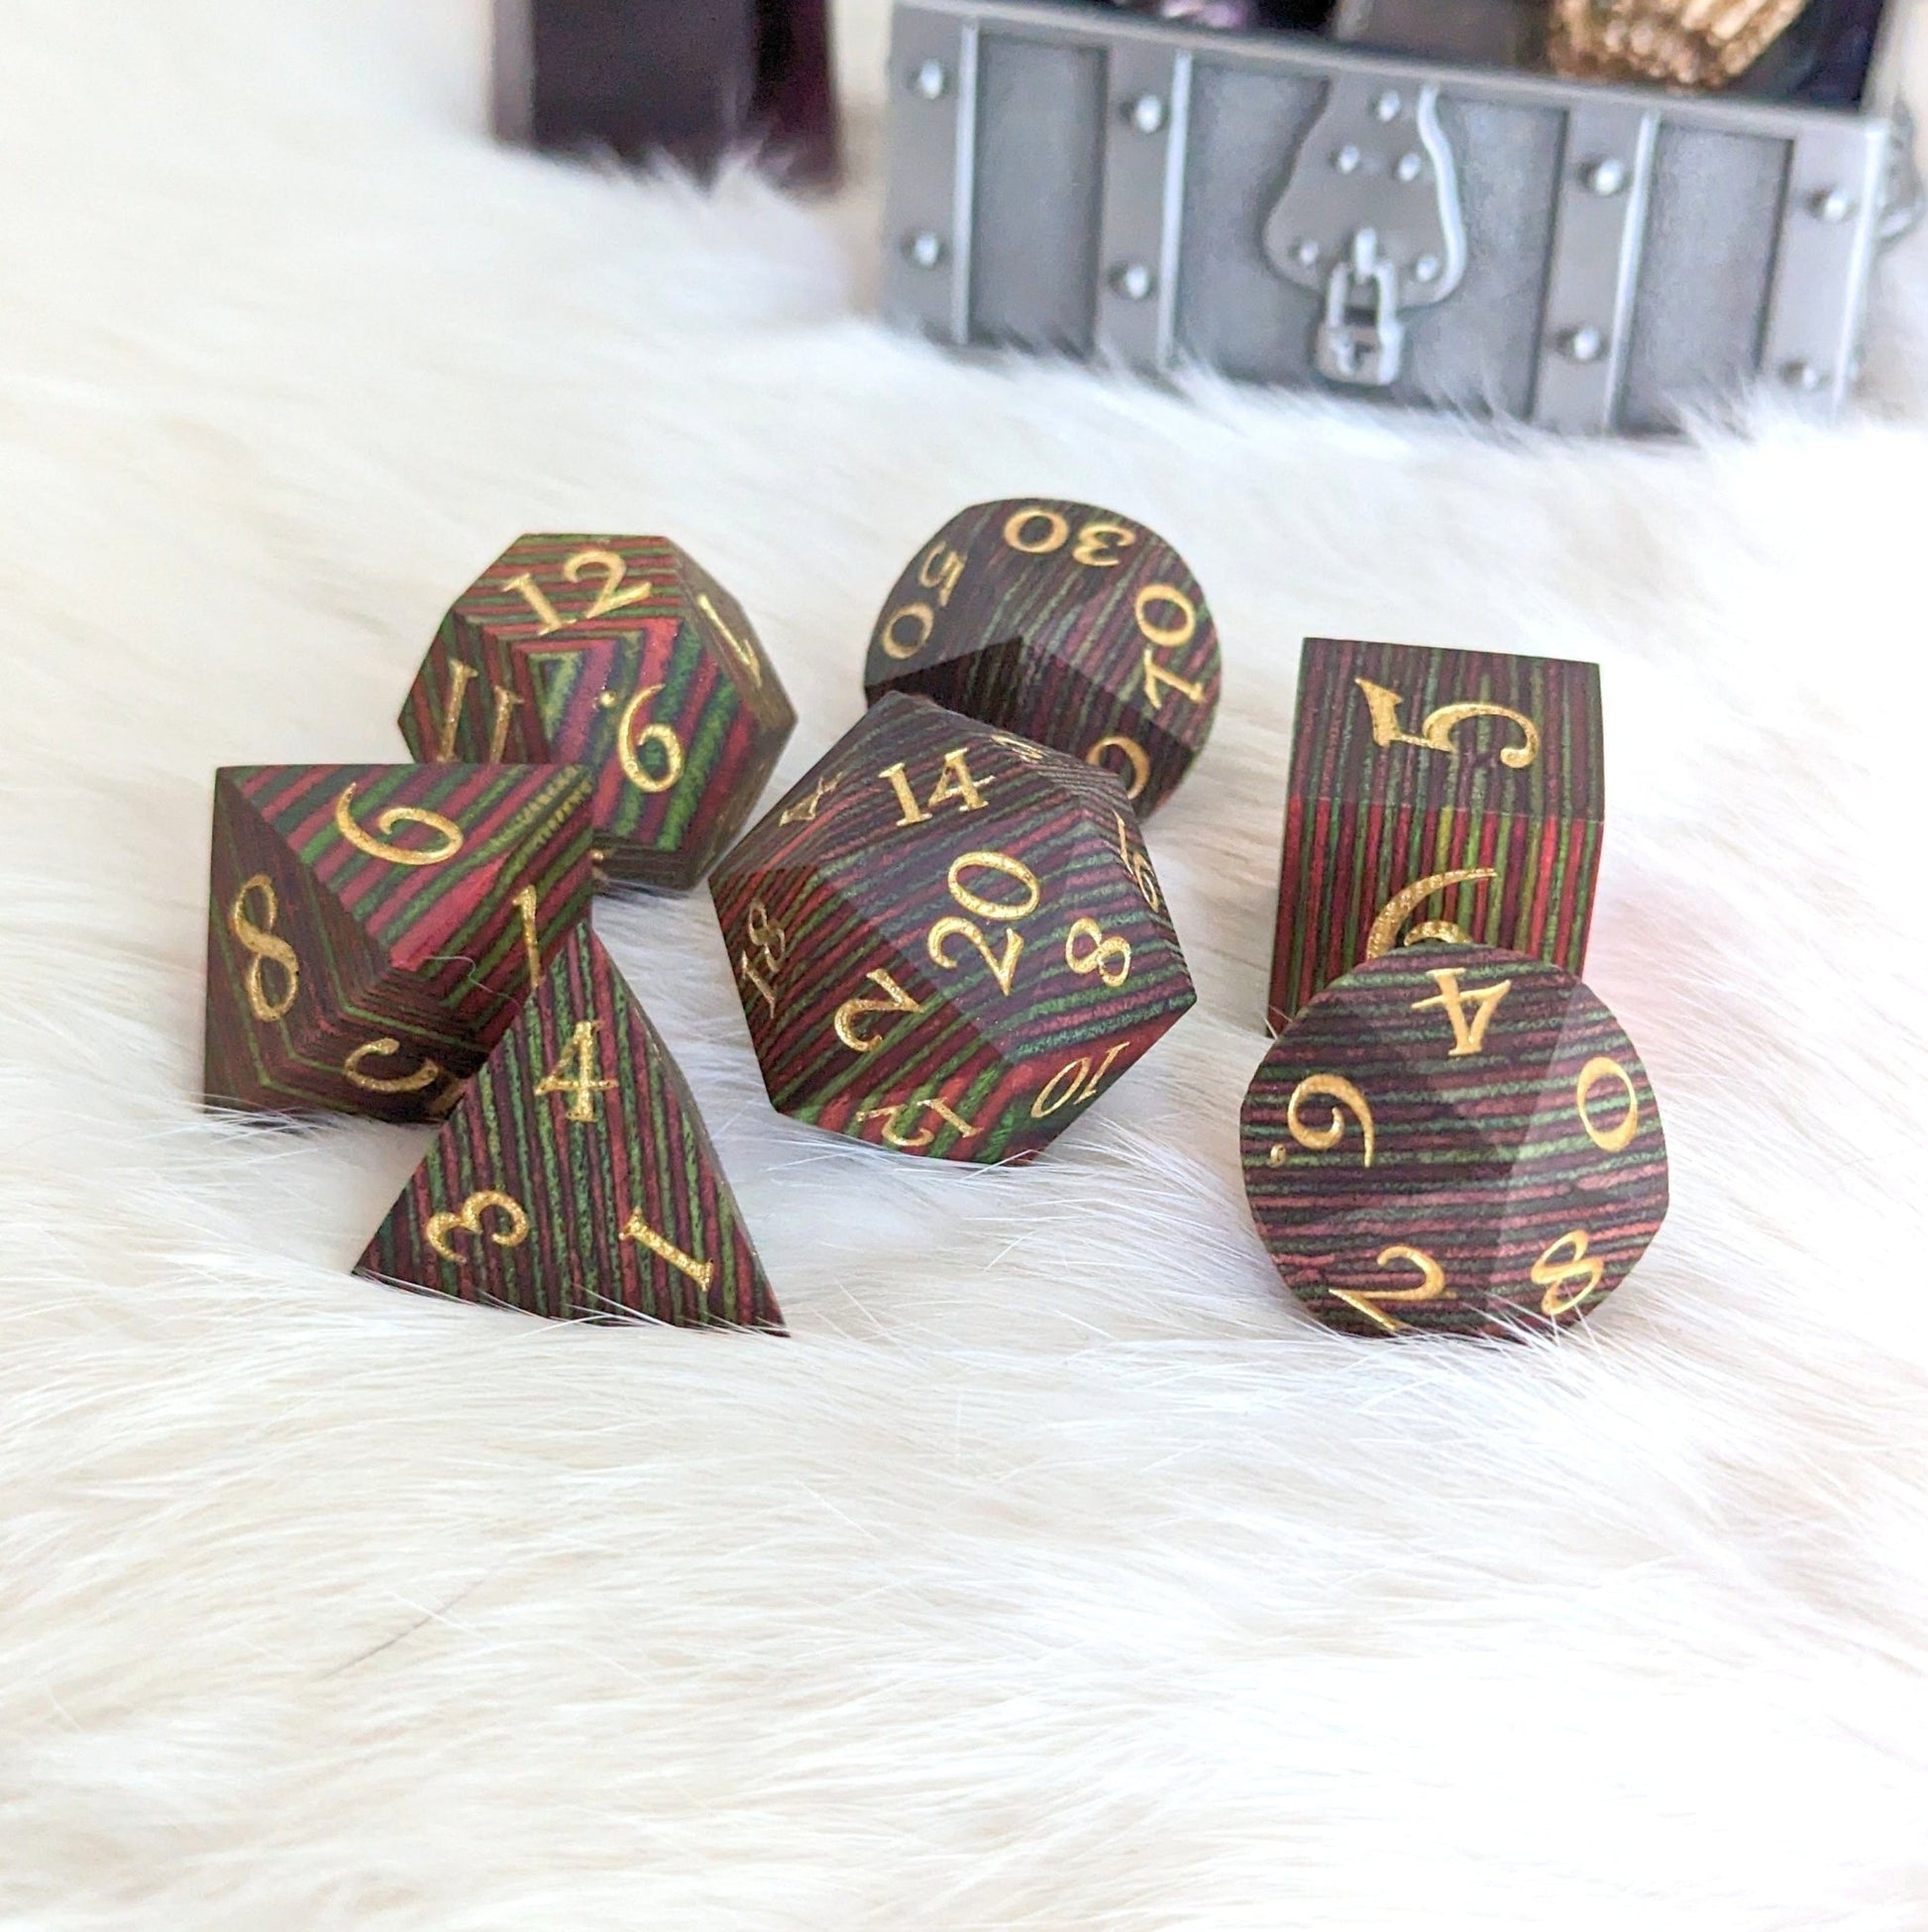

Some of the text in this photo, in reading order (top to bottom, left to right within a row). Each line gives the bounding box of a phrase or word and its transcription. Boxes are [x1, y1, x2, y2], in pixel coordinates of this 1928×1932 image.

[1003, 507, 1135, 569] 30
[500, 550, 654, 637] 12
[881, 537, 970, 661] 50
[1133, 582, 1207, 711] 10
[1353, 676, 1540, 769] 5
[335, 781, 465, 866] 6
[878, 746, 996, 828] 14
[232, 874, 298, 1022] 8
[926, 849, 1040, 998] 20
[1065, 916, 1133, 988] 8
[833, 968, 925, 1054] 2
[1412, 966, 1513, 1057] 4
[534, 1019, 619, 1123] 4
[1029, 1040, 1131, 1120] 10
[1576, 1055, 1640, 1154] 0
[855, 1096, 984, 1147] 12
[425, 1189, 529, 1265] 3
[618, 1205, 714, 1292] 1
[1329, 1244, 1458, 1331] 2
[1529, 1229, 1604, 1316] 8
